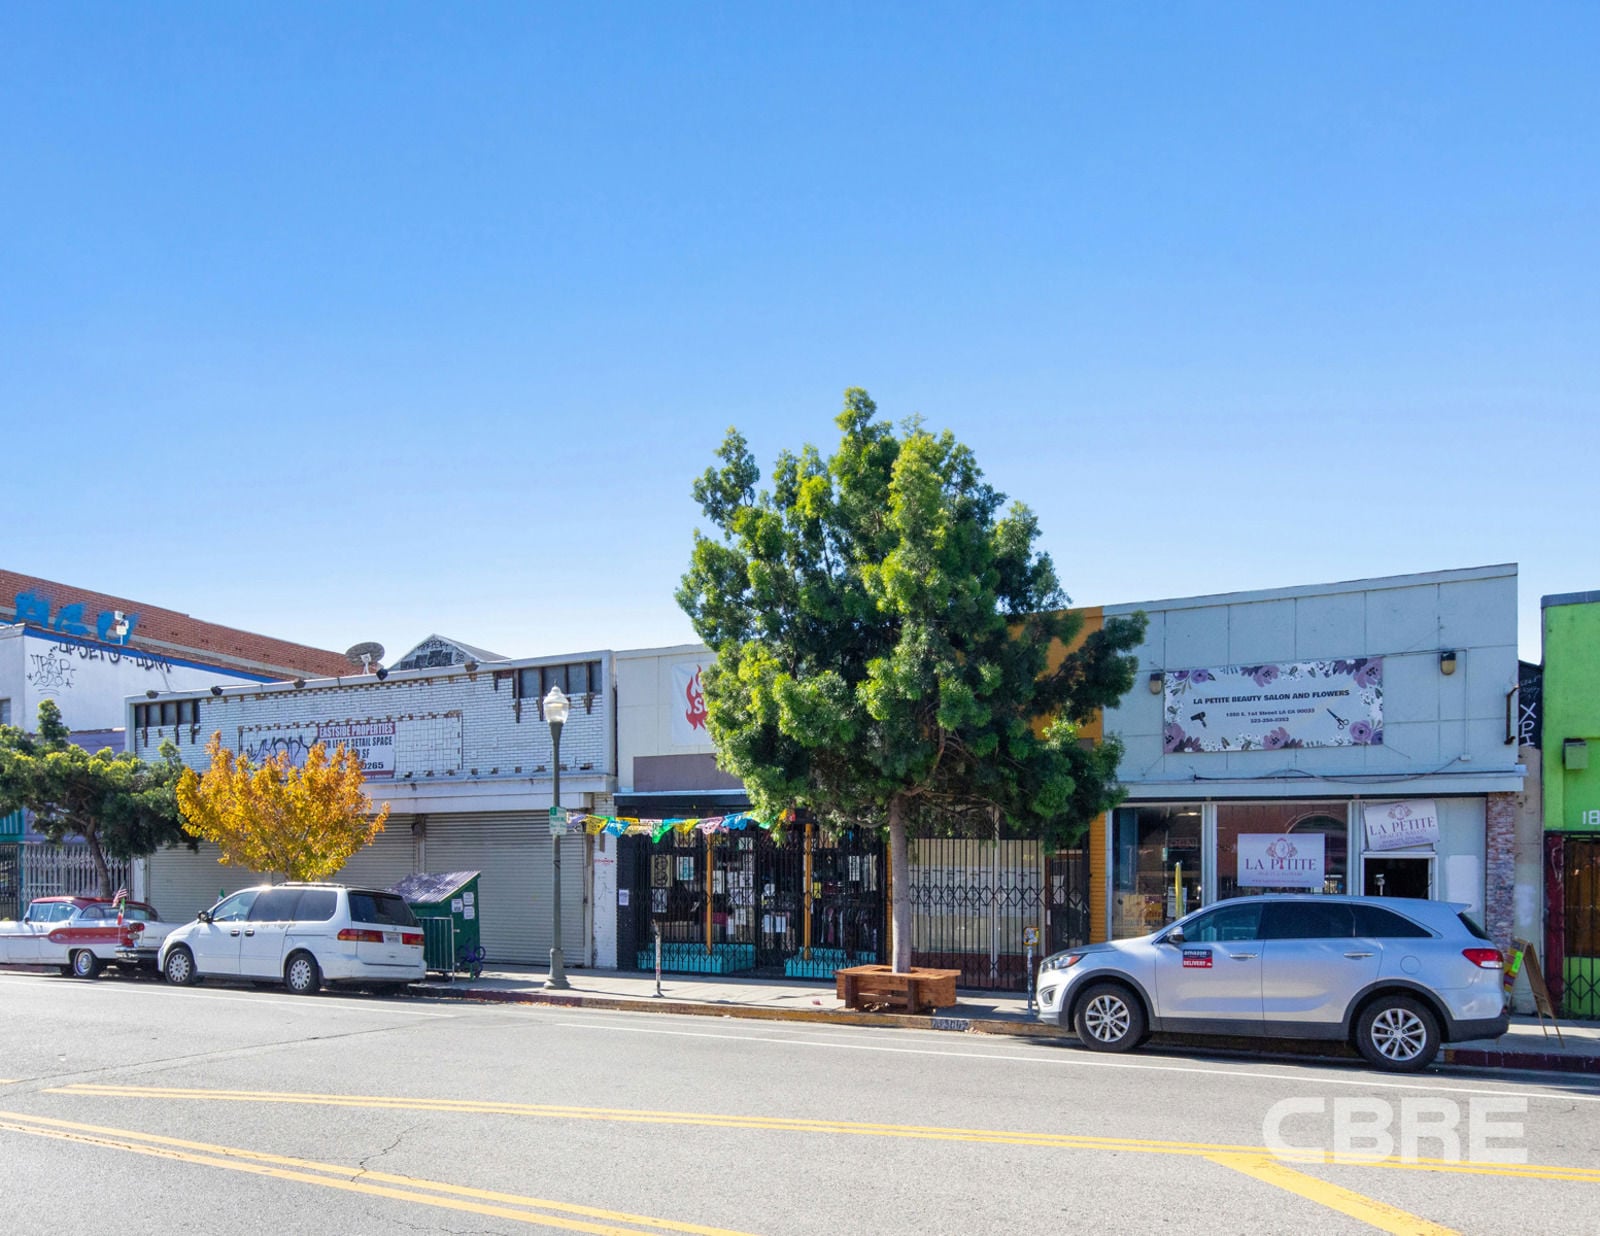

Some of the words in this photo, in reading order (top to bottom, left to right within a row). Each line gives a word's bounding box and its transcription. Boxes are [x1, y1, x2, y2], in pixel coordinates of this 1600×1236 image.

[1263, 693, 1291, 701] SALON
[1292, 691, 1310, 699] AND
[1312, 689, 1350, 698] FLOWERS
[320, 725, 351, 738] EASTSIDE
[352, 722, 393, 736] PROPERTIES
[372, 736, 392, 746] SPACE
[1370, 824, 1387, 836] LA
[1392, 816, 1436, 832] PETITE
[1246, 858, 1264, 870] LA
